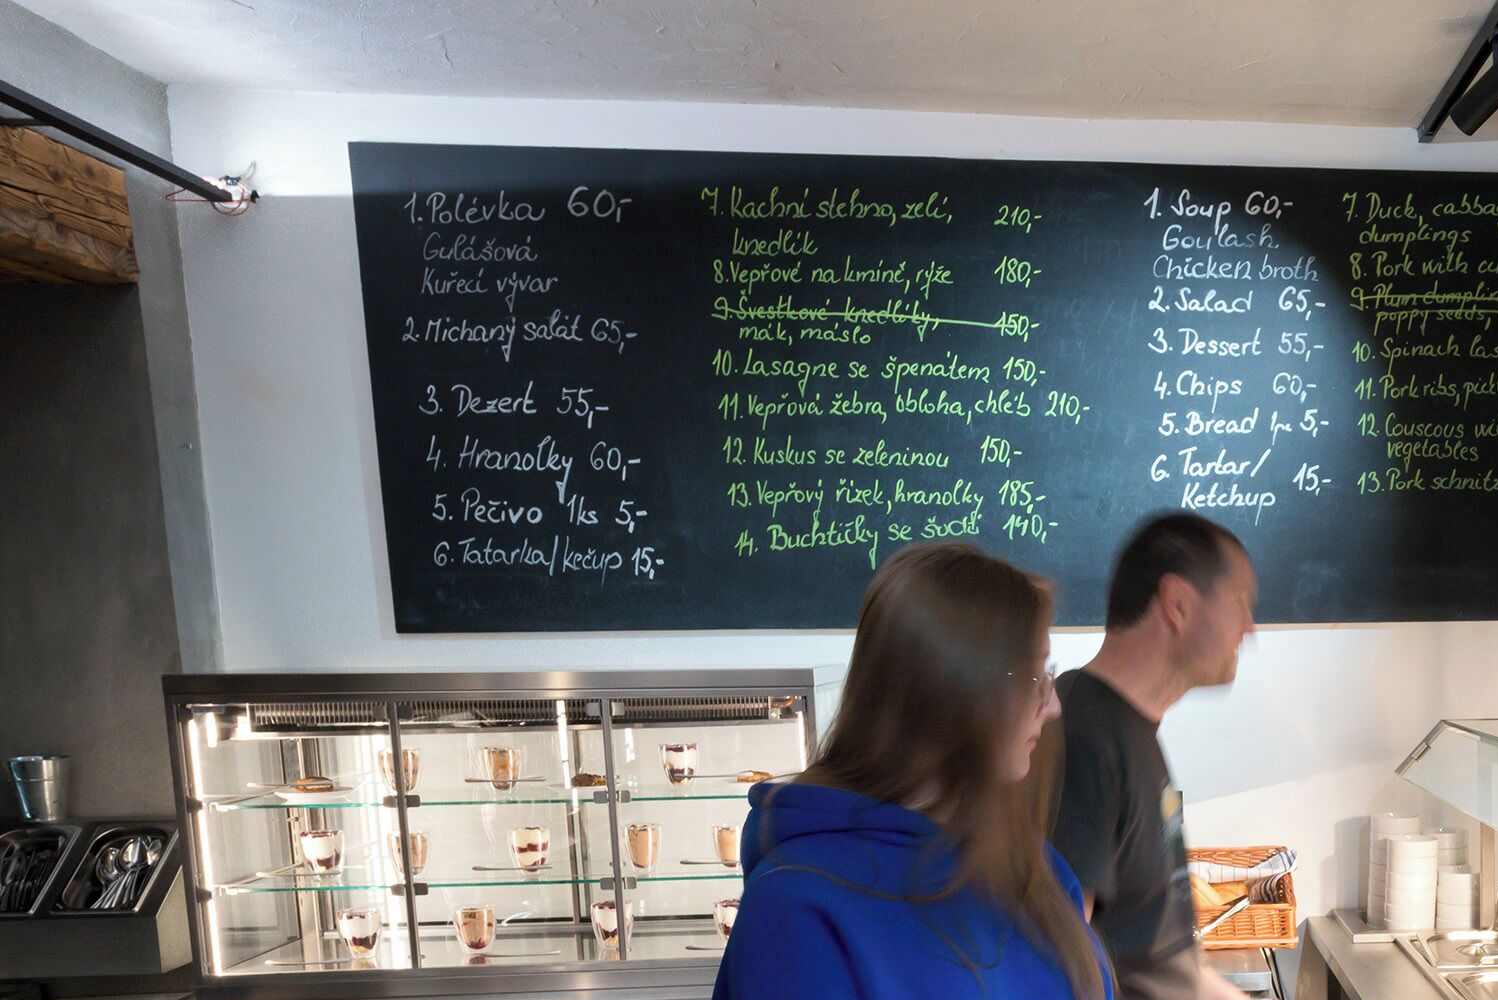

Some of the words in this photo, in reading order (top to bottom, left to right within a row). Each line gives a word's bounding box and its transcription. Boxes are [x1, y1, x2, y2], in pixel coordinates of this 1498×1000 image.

[567, 186, 632, 222] 60,-
[731, 186, 811, 219] Kachní
[993, 205, 1042, 233] 210,-
[1144, 187, 1162, 220] 1.
[1171, 189, 1231, 236] Soup
[1245, 191, 1293, 219] 60,-
[423, 232, 538, 262] Gulášová
[733, 227, 818, 257] knedlík
[1359, 223, 1472, 256] dumplings
[729, 259, 802, 294] Vepřové
[811, 267, 837, 284] na
[915, 261, 954, 299] rýže
[994, 256, 1042, 288] 180,-
[1153, 254, 1252, 280] Chicken
[1258, 254, 1319, 281] broth
[1372, 251, 1415, 277] Pork
[1423, 251, 1468, 273] with
[421, 267, 488, 295] Kuřecí
[496, 272, 558, 312] vývar
[1149, 285, 1170, 312] 2.
[1174, 287, 1254, 313] Salad
[1278, 285, 1326, 321] 65,-
[1374, 283, 1418, 308] Plum
[523, 308, 583, 342] salát
[591, 318, 638, 354] 65,-
[739, 323, 793, 346] mák,
[800, 323, 871, 345] máslo
[1373, 310, 1428, 336] poppy
[1148, 327, 1173, 353] 3.
[1178, 328, 1262, 356] Dessert
[1278, 332, 1324, 362] 55,-
[1352, 341, 1376, 363] 10.
[1380, 335, 1461, 375] Spinach
[712, 349, 738, 377] 10.
[742, 349, 840, 397] Lasagne
[848, 362, 869, 377] se
[881, 351, 991, 393] špenátem
[1002, 356, 1046, 386] 150,-
[1379, 374, 1419, 399] Pork
[418, 384, 443, 415] 3.
[451, 380, 537, 418] Dezert
[556, 387, 609, 429] 55,-
[1154, 371, 1171, 400] 4.
[1176, 370, 1243, 413] Chips
[1273, 373, 1317, 403] 60,-
[747, 393, 823, 430] Vepřová
[974, 391, 1031, 417] chléb
[1044, 390, 1090, 425] 210,-
[1159, 412, 1179, 436] 5.
[1185, 407, 1259, 436] Bread
[1300, 409, 1329, 437] 5,-
[1357, 412, 1379, 436] 12.
[1385, 413, 1464, 438] Couscous
[722, 436, 746, 464] 12.
[753, 439, 816, 465] Kuskus
[824, 450, 846, 465] se
[852, 439, 950, 468] zeleninou
[980, 434, 1023, 467] 150,-
[1387, 441, 1479, 473] vegetables
[426, 434, 446, 472] 4.
[458, 434, 573, 504] Hranolky
[590, 440, 641, 482] 60,-
[1151, 454, 1170, 482] 6.
[1293, 462, 1332, 496] 15,-
[1357, 471, 1384, 494] 13.
[1385, 467, 1425, 490] Pork
[432, 493, 453, 522] 5.
[461, 487, 544, 525] Pečivo
[616, 500, 648, 534] 5,-
[756, 480, 823, 522] Vepřový
[895, 479, 984, 520] hranolky
[998, 480, 1046, 514] 185,-
[1181, 482, 1276, 526] Ketchup
[888, 522, 913, 541] se
[1002, 514, 1059, 545] 140,-
[631, 546, 664, 580] 15,-
